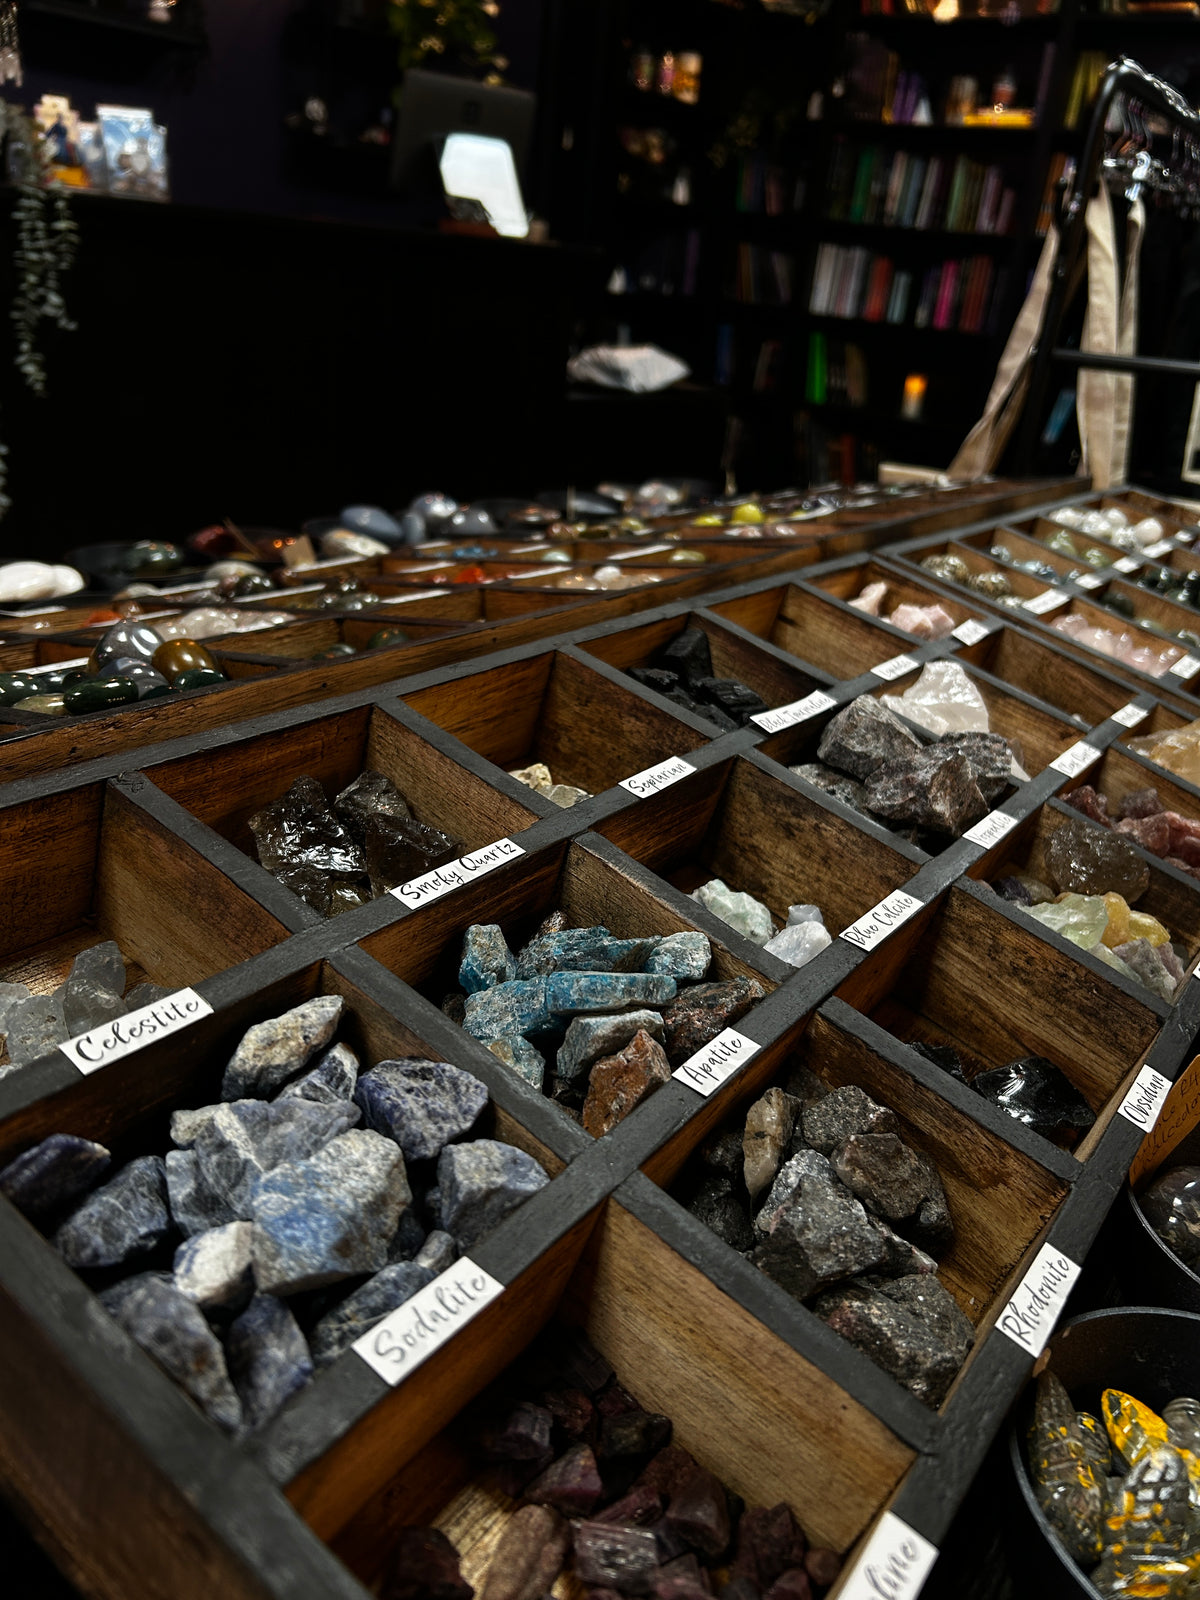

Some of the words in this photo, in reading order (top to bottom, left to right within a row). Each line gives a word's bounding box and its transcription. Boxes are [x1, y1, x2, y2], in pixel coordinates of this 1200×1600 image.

[628, 763, 687, 793] Septarian
[400, 870, 465, 900] Smoky
[459, 843, 517, 872] Quartz
[843, 925, 880, 946] Blue
[871, 897, 914, 926] Calcite
[75, 1000, 200, 1063] Celestite
[682, 1038, 743, 1086] Apatite
[1123, 1073, 1166, 1124] Obsidian
[374, 1274, 487, 1364] Sodalite
[1001, 1257, 1070, 1347] Rhodonite
[863, 1536, 921, 1600] line
